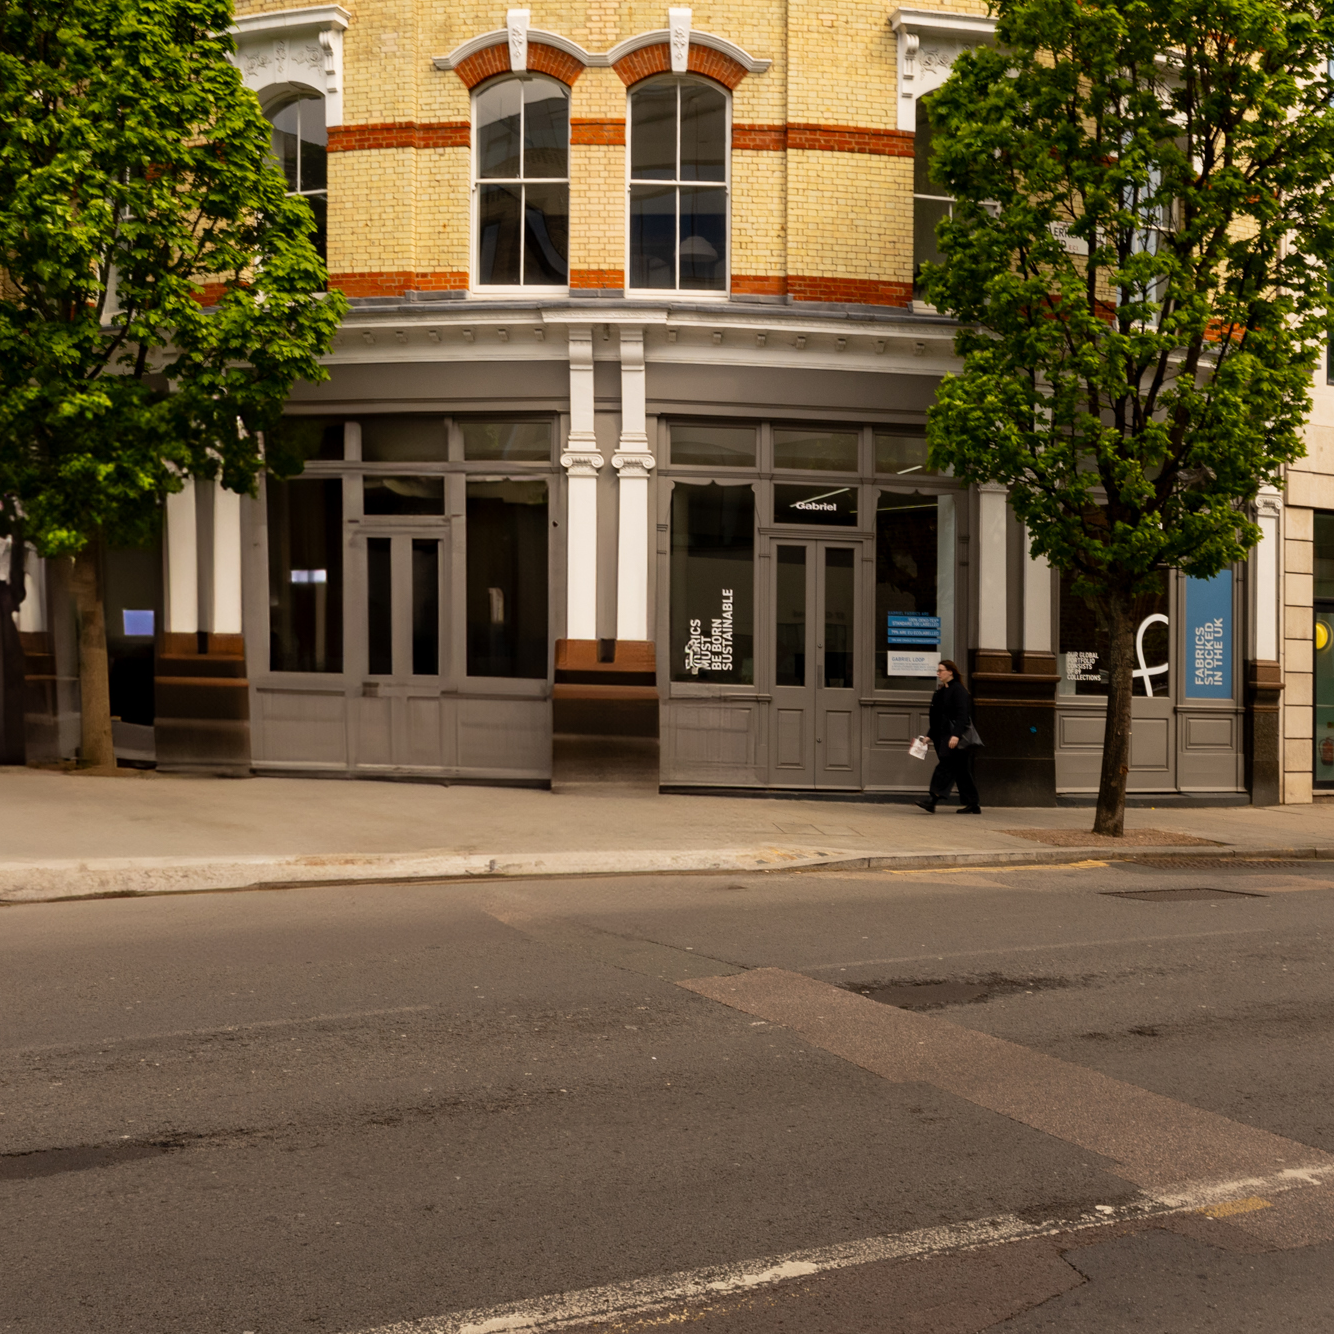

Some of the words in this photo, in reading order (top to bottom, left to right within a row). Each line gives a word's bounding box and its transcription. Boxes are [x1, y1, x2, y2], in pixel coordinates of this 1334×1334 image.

[795, 501, 837, 511] Gabriel
[711, 618, 722, 652] BORN
[722, 588, 733, 671] SUSTAINABLE
[1214, 617, 1223, 637] UK
[701, 635, 711, 670] MUST
[711, 654, 722, 670] BE
[1079, 651, 1099, 659] GLOBAL
[1195, 627, 1205, 685] FABRICS
[1204, 622, 1214, 686] STOCKED
[1214, 641, 1223, 666] THE
[1214, 671, 1223, 686] IN
